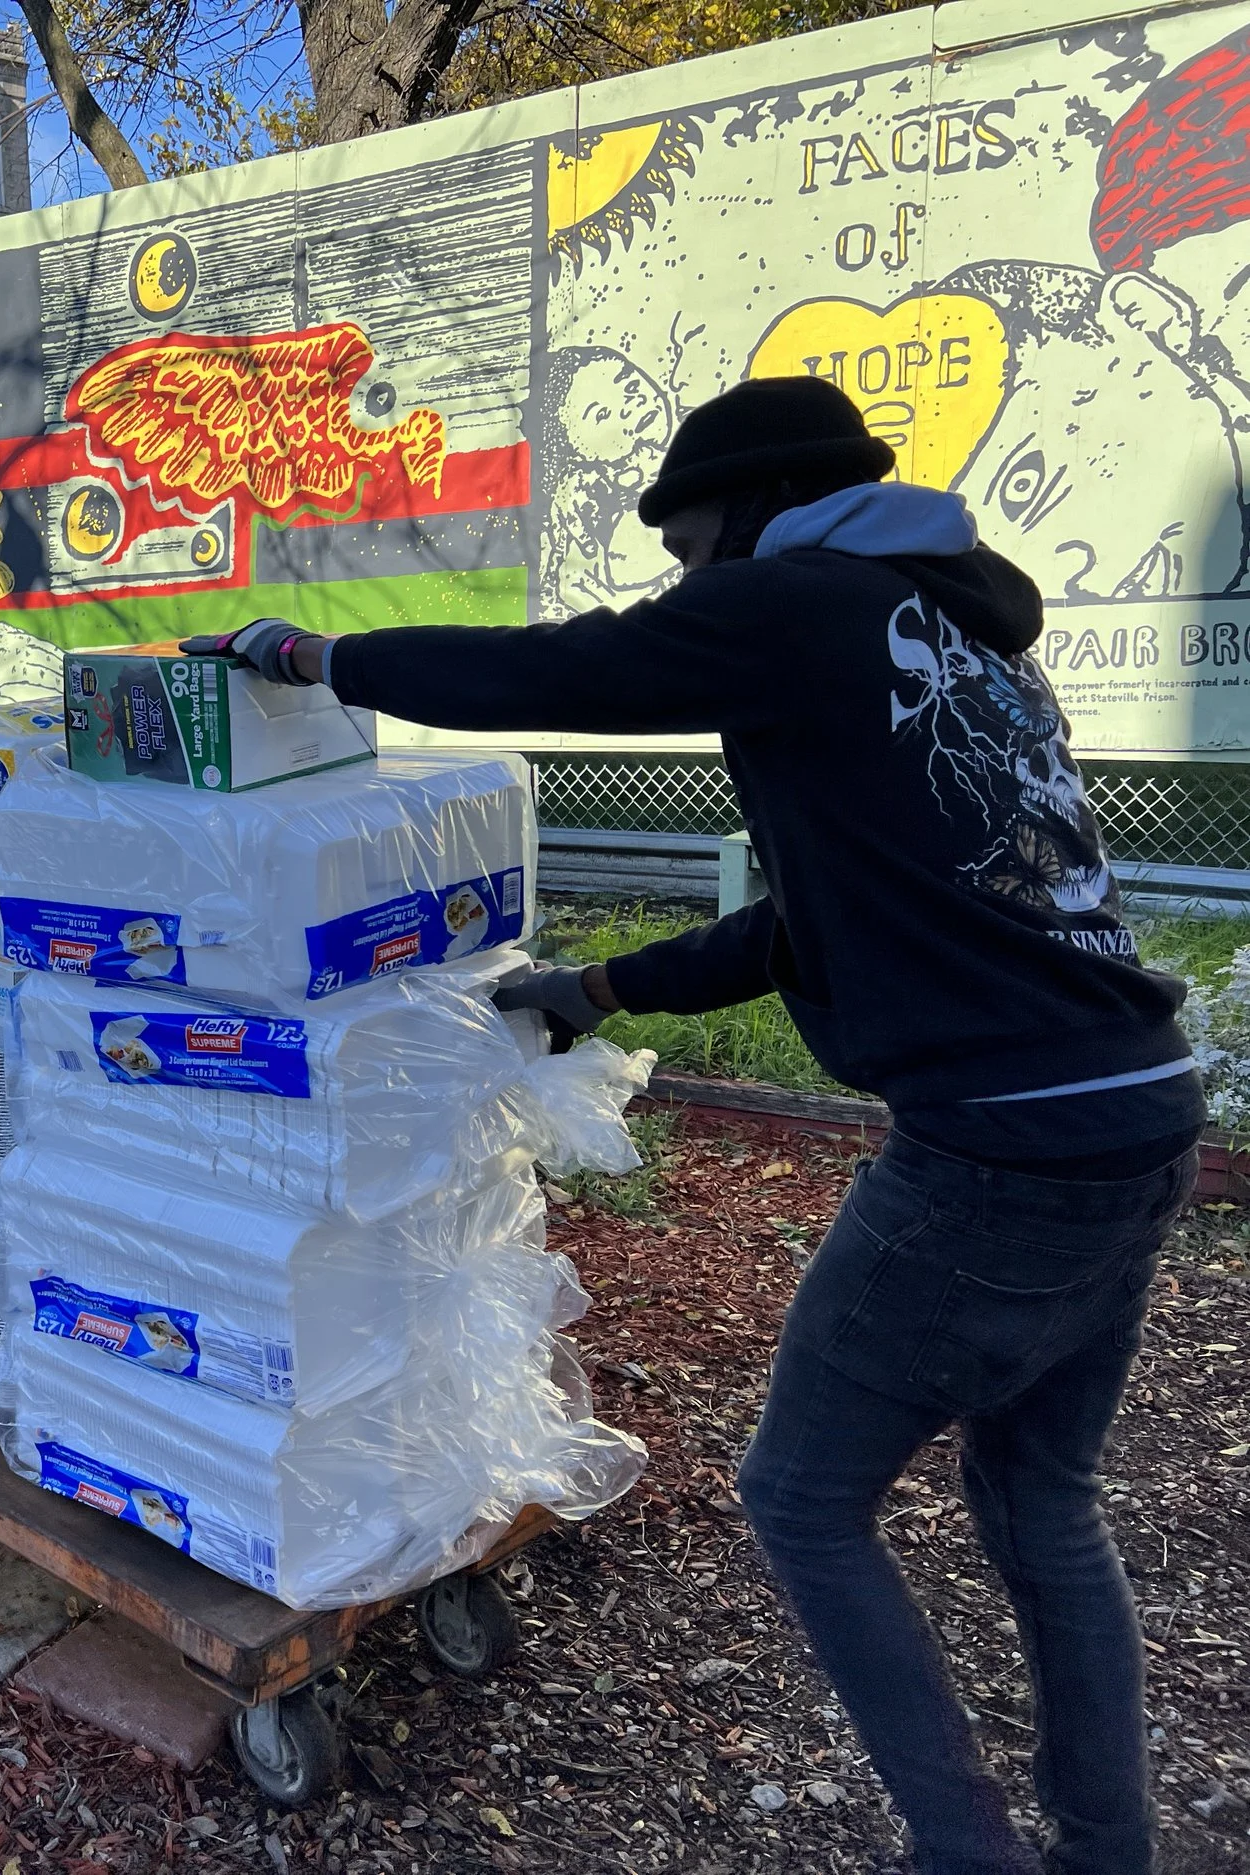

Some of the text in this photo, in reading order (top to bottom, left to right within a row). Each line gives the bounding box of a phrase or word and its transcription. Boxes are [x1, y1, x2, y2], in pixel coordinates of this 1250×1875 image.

[798, 98, 1017, 195] FACES
[835, 201, 926, 272] of
[802, 336, 972, 395] HOPE
[1034, 625, 1160, 671] PAIR
[171, 662, 190, 698] 90
[1062, 682, 1106, 692] empower
[1108, 679, 1151, 692] formerly
[1154, 676, 1219, 689] incarcerated
[1222, 676, 1240, 688] and
[1058, 692, 1179, 704] ect at Stateville Prison.
[190, 662, 203, 758] Large Yard Bags
[131, 685, 153, 759] POWER
[148, 697, 167, 750] FLEX
[7, 945, 38, 966] 125
[54, 944, 93, 958] SUPREME
[378, 938, 420, 959] SUPREME
[55, 957, 85, 974] Hefty
[311, 970, 344, 994] 125
[193, 1019, 240, 1035] Hefty
[266, 1021, 305, 1043] 125
[173, 1056, 210, 1066] Compartment
[210, 1057, 229, 1068] Hinged
[229, 1057, 238, 1067] Lid
[238, 1058, 269, 1068] Containers
[38, 1316, 66, 1338] 125
[81, 1318, 125, 1338] SUPREME
[81, 1487, 121, 1511] SUPREME
